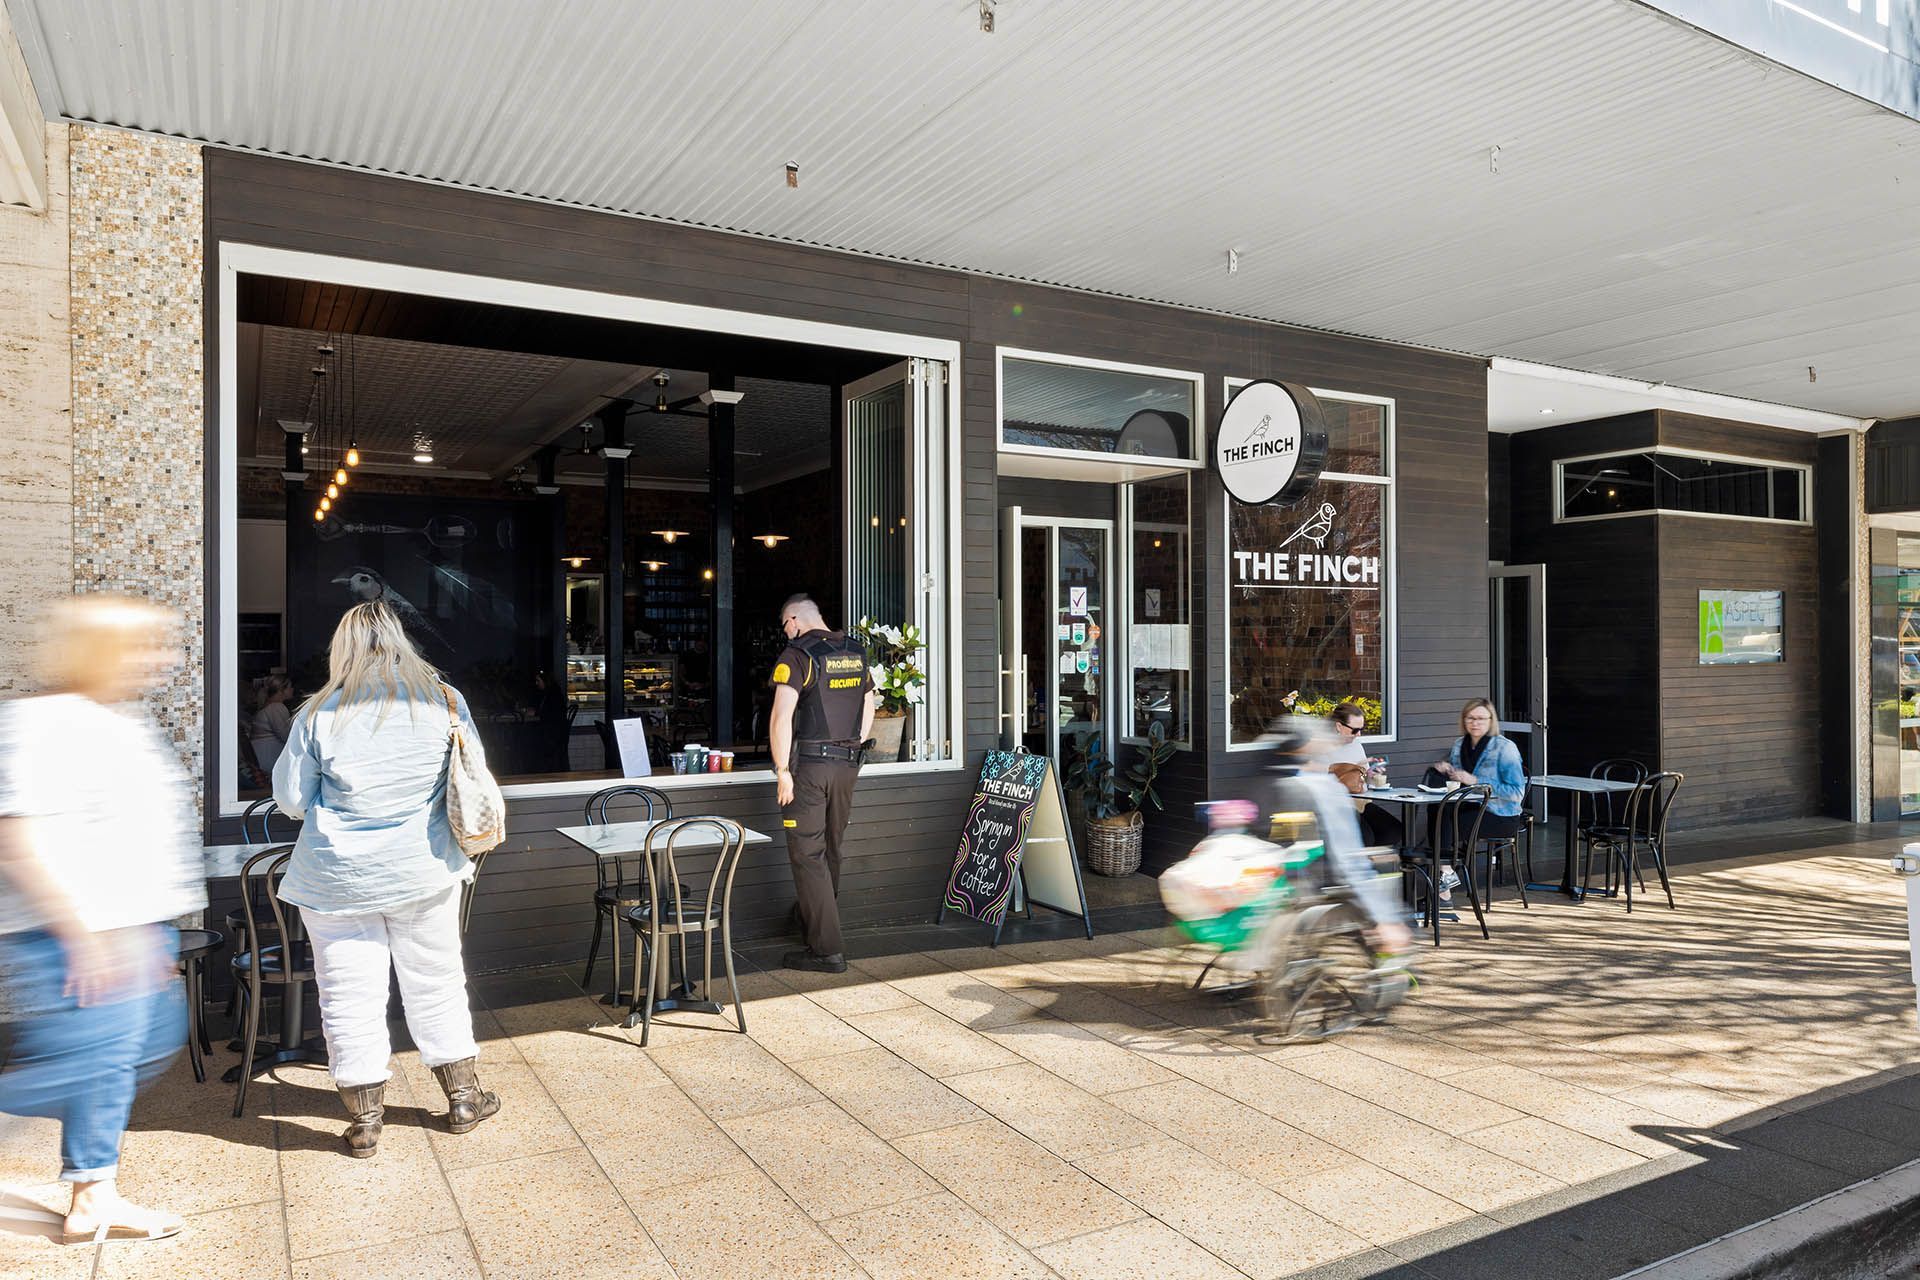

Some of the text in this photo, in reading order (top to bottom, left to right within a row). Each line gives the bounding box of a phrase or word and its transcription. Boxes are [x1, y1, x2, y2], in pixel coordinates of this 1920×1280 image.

[1224, 436, 1294, 463] THE FINCH
[1233, 551, 1379, 583] THE FINCH
[830, 678, 861, 688] SECURITY
[982, 778, 1034, 800] THE FINCH
[972, 808, 1004, 850] Spring
[971, 838, 997, 871] for a
[960, 866, 1002, 897] coffee!
